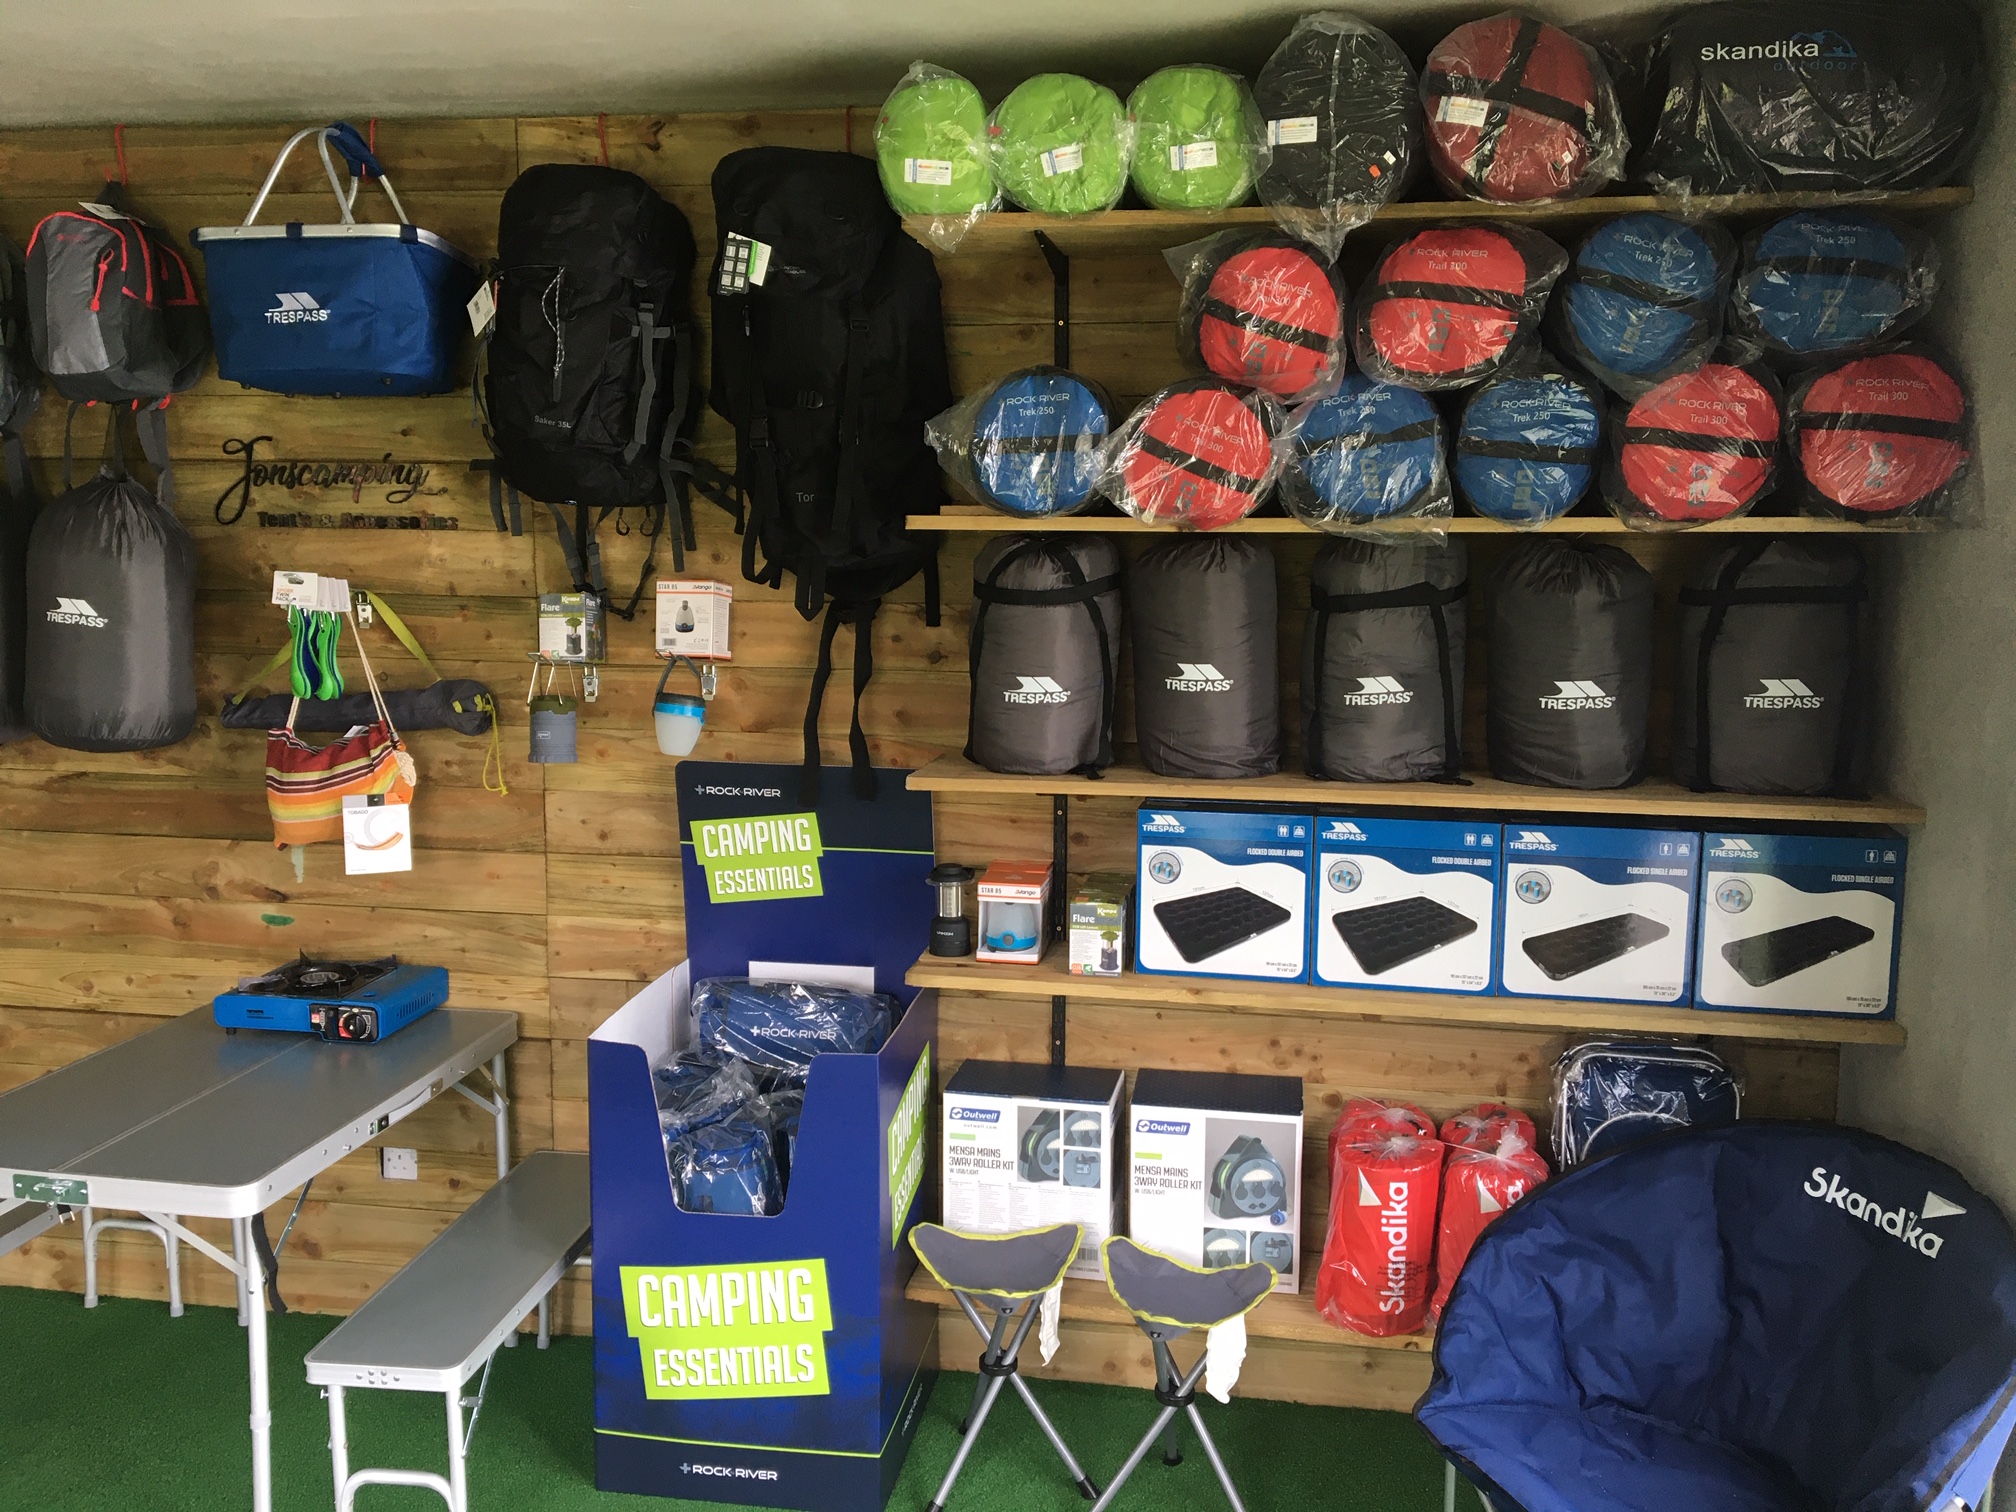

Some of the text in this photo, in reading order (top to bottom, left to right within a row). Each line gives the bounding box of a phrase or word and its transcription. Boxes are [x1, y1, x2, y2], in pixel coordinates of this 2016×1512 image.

[1701, 40, 1819, 61] skandika
[1773, 60, 1858, 72] outdoor
[1624, 235, 1657, 250] ROCK
[1816, 234, 1856, 244] Trek 250
[1416, 248, 1488, 258] ROCK RIVER
[1635, 251, 1653, 263] Trek
[1428, 260, 1468, 271] Trail 300
[264, 310, 329, 325] TRESPASS
[1855, 378, 1929, 390] ROCK RIVER
[1006, 393, 1070, 406] ROCK RIVER
[1323, 392, 1392, 407] ROCK RIVER
[1868, 391, 1909, 401] Trail 300
[1501, 398, 1571, 411] ROCK RIVER
[1678, 399, 1712, 410] ROCK
[1019, 406, 1055, 417] Trek 250
[1337, 406, 1357, 417] Trek
[1513, 412, 1551, 422] Trek 250
[534, 414, 572, 429] Saker 35L
[1690, 413, 1728, 425] Trail 300
[1208, 441, 1224, 453] 300
[795, 492, 815, 503] Tor
[540, 603, 560, 612] Flare
[46, 611, 105, 628] TRESPASS
[1164, 678, 1231, 692] TRESPASS
[1003, 691, 1068, 705] TRESPASS
[1344, 692, 1411, 706] TRESPASS
[1539, 697, 1613, 710] TRESPASS
[1743, 697, 1821, 709] TRESPASS
[706, 786, 781, 797] ROCK RIVER
[1142, 824, 1185, 833] TRESPASS
[702, 818, 812, 858] CAMPING
[1321, 832, 1367, 841] TRESPASS
[1247, 847, 1304, 857] FLOCKED DOUBLE AIRBED
[1509, 842, 1557, 851] TRESPASS
[1709, 849, 1758, 858] TRESPASS
[1431, 856, 1492, 867] FLOCKED DOUBLE AIRBED
[1627, 867, 1688, 876] FLOCKED SINGLE AIRBED
[714, 864, 814, 895] ESSENTIALS
[1831, 874, 1894, 884] FLOCKED SINGLE AIRBED
[1097, 907, 1117, 916] Kampa
[1072, 914, 1095, 923] Flare
[761, 1027, 837, 1041] ROCK RIVER
[892, 1056, 927, 1177] CAMPING
[963, 1110, 998, 1120] Outwell
[1150, 1123, 1187, 1133] Outwell
[949, 1145, 1001, 1158] MENSA MAINS
[949, 1156, 1015, 1171] 3WAY ROLLER KIT
[894, 1124, 926, 1231] ESSENTIALS
[1134, 1165, 1189, 1178] MENSA MAINS
[1134, 1176, 1203, 1190] 3WAY ROLLER KIT
[1803, 1167, 1944, 1259] Skandika
[1379, 1181, 1408, 1315] Skandika
[637, 1268, 815, 1328] CAMPING
[653, 1344, 815, 1387] ESSENTIALS
[692, 1464, 778, 1481] ROCK RIVER
